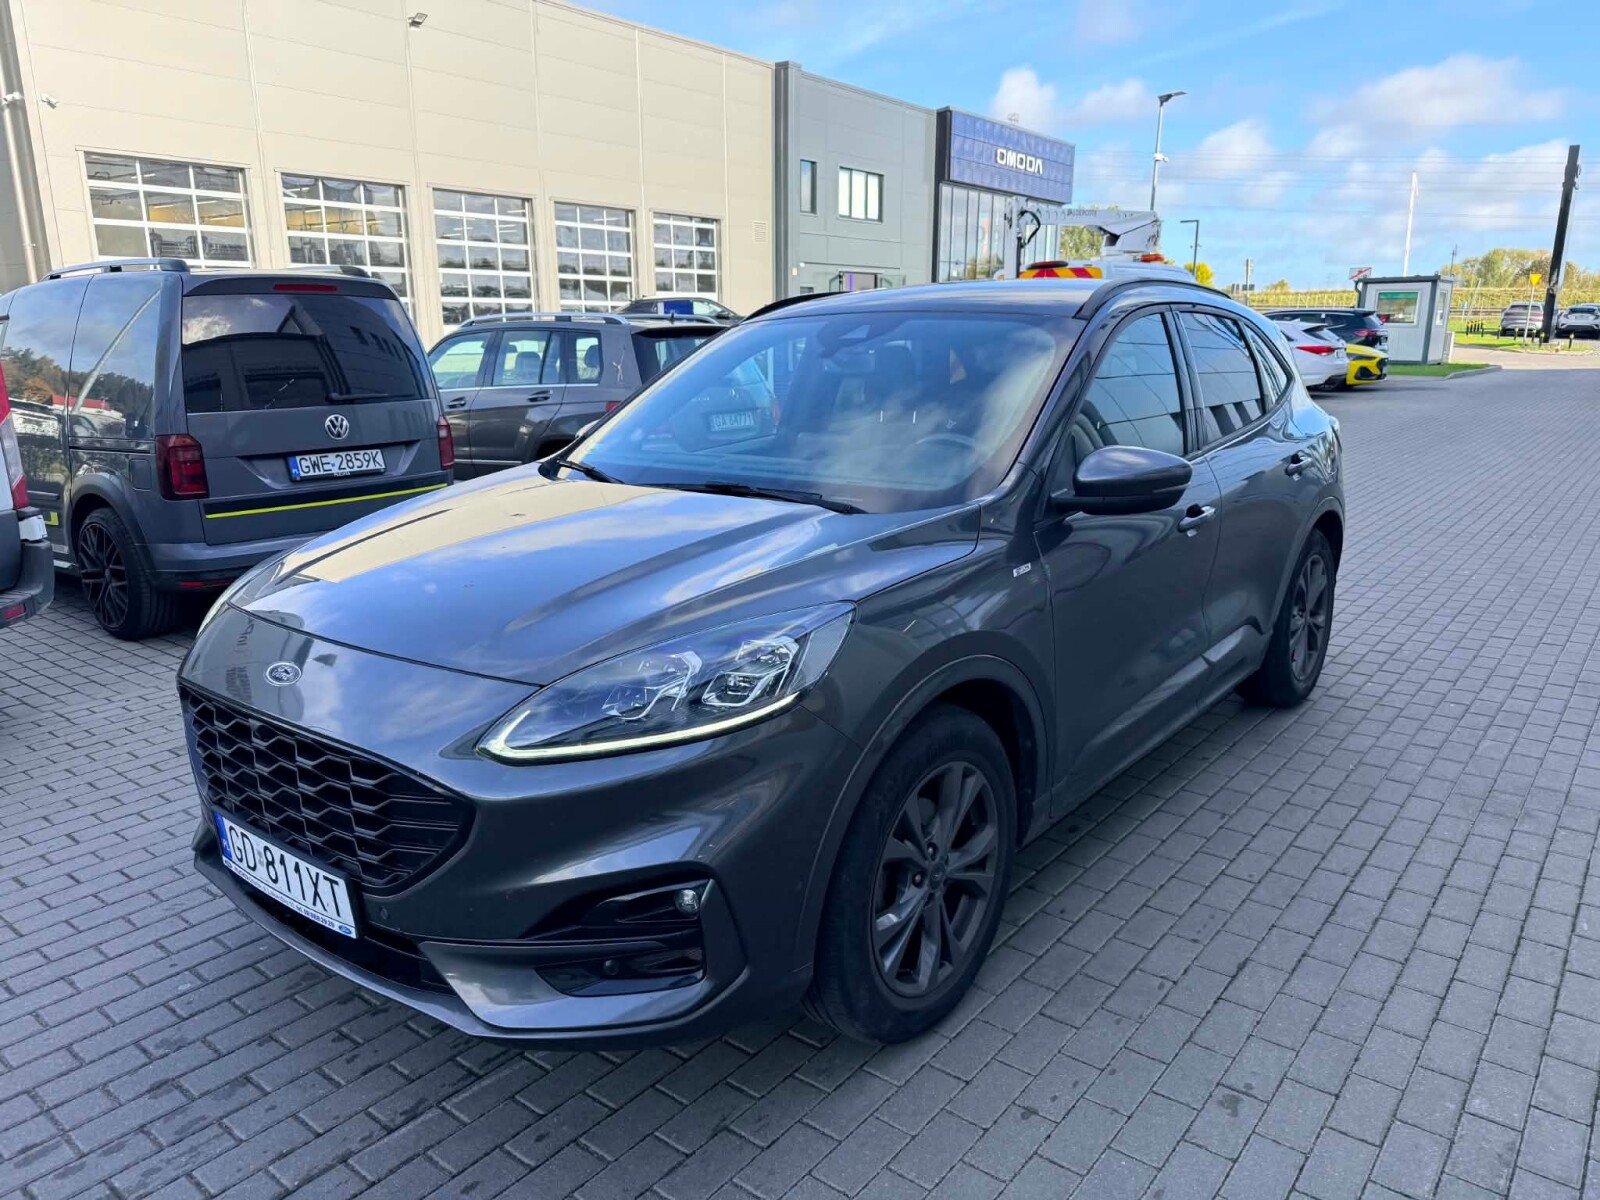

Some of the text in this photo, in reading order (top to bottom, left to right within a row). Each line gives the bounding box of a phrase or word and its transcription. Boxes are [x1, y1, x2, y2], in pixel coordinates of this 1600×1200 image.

[996, 149, 1043, 175] OMODA
[299, 451, 383, 474] GWE 2859K
[229, 825, 257, 872] GD
[263, 845, 340, 918] 811XT
